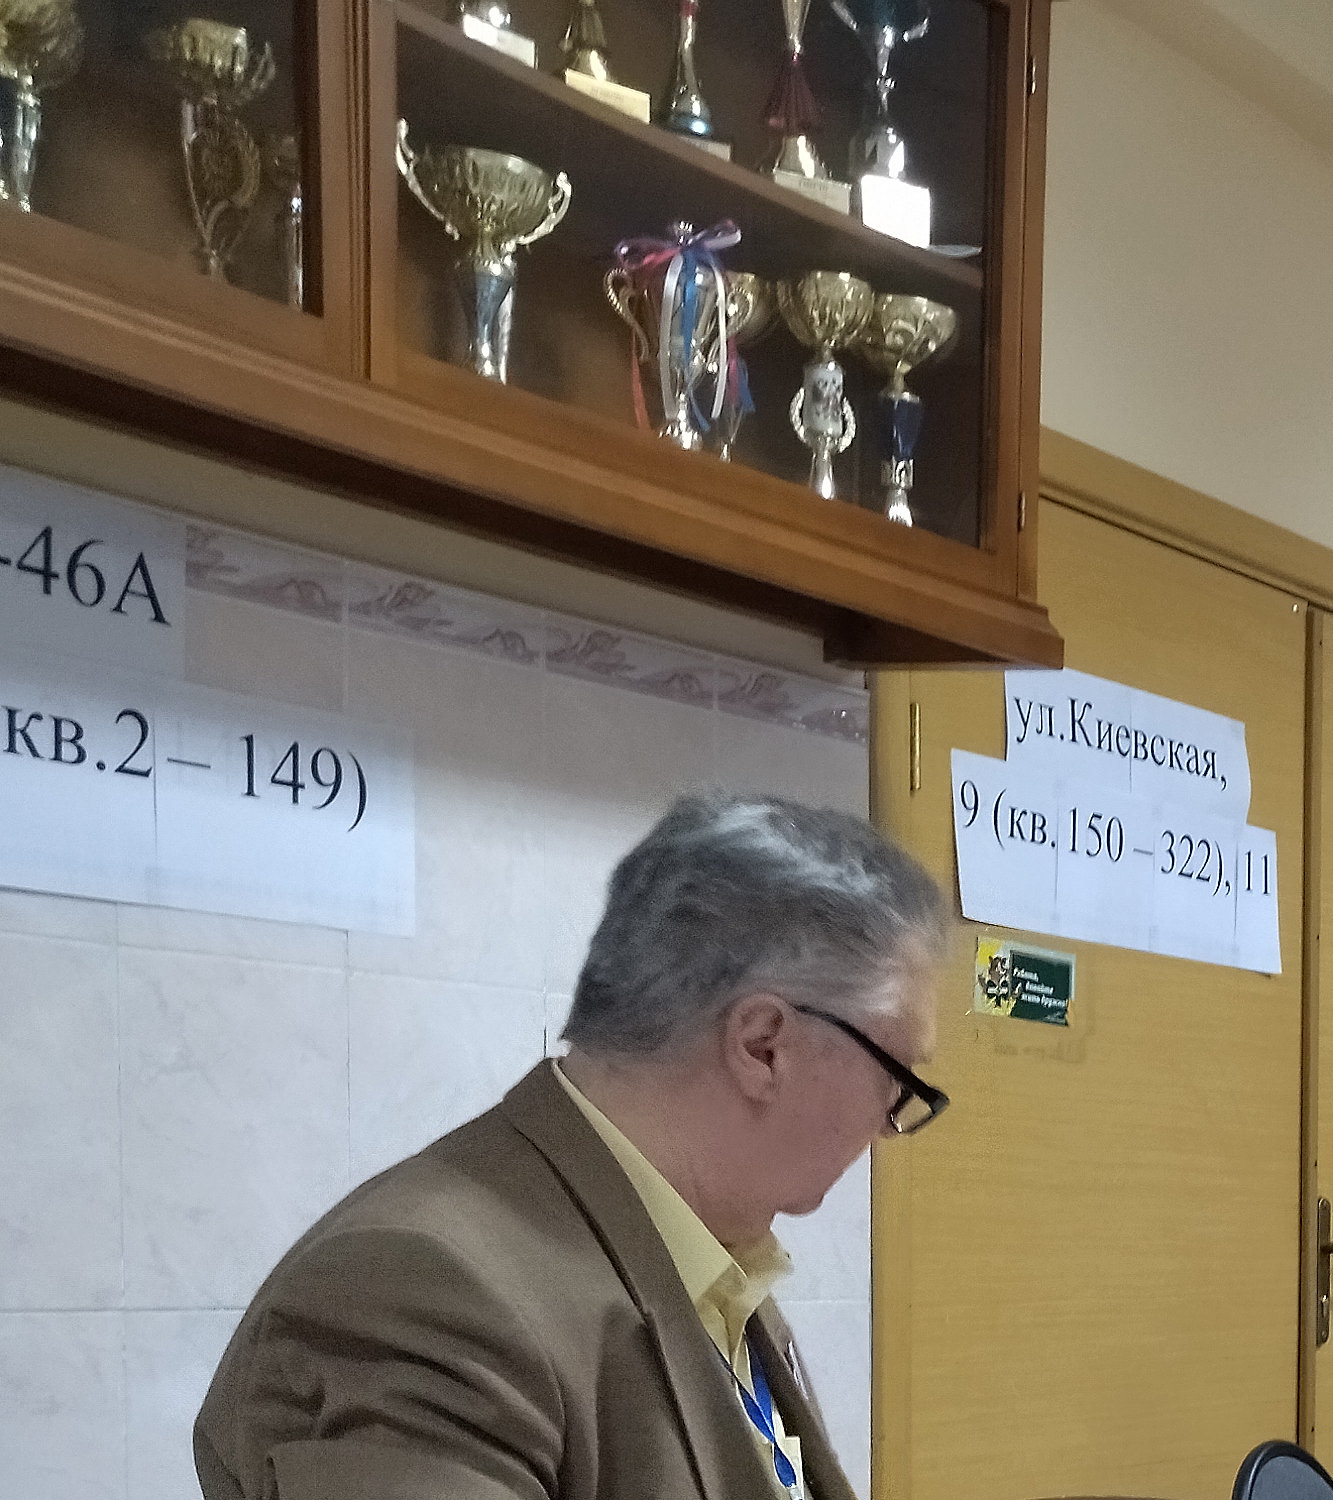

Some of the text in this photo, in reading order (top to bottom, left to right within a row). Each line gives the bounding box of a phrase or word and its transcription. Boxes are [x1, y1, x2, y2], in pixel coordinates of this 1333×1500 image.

[1, 704, 153, 778] кв.2
[240, 734, 368, 832] 149)
[1013, 696, 1229, 792] ул.Киевская,
[960, 779, 980, 828] 9
